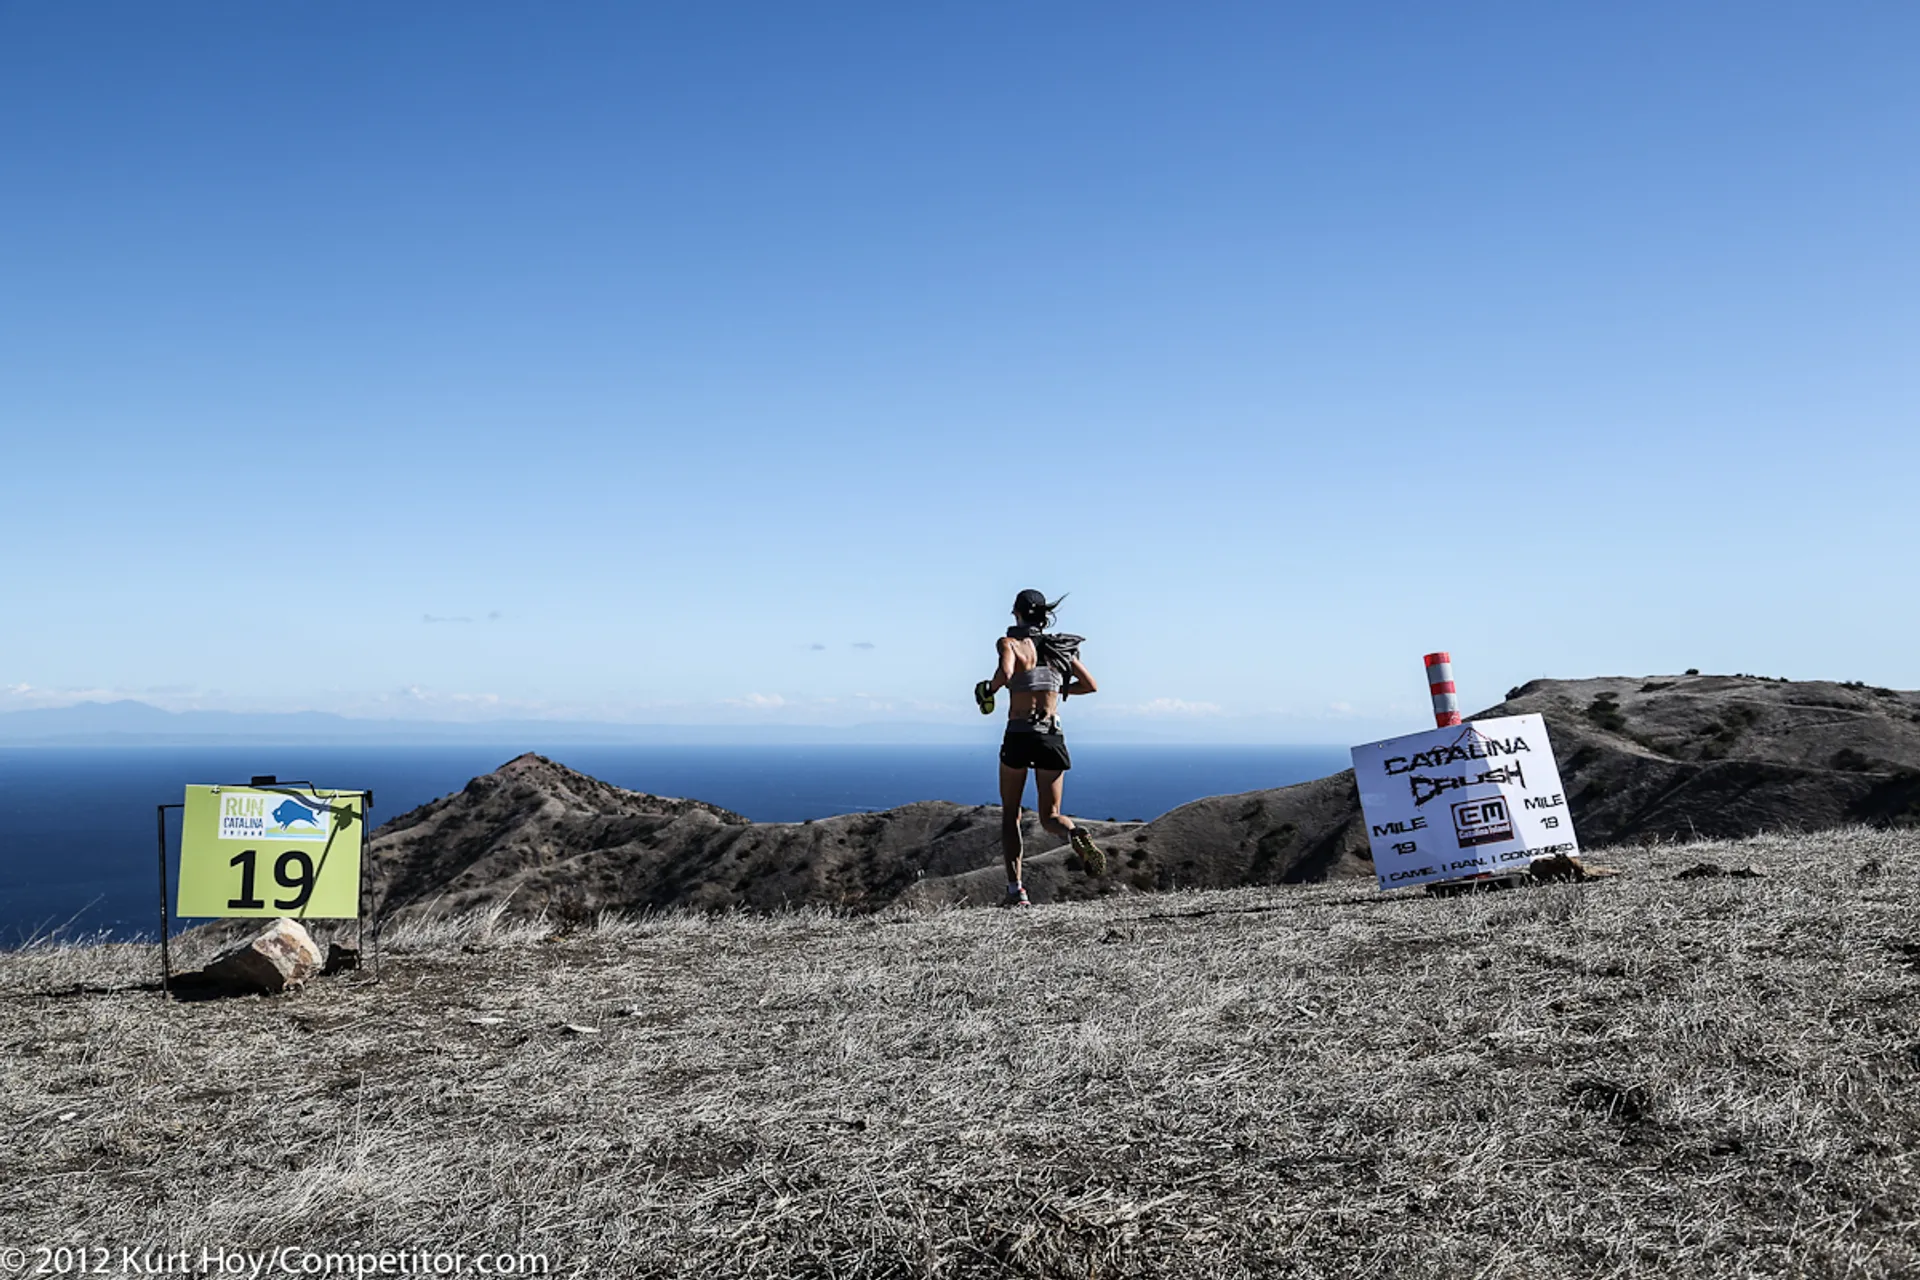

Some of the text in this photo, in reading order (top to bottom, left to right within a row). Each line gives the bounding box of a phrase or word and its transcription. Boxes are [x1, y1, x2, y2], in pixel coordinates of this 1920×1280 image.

[1384, 737, 1531, 776] CATALINA
[1409, 759, 1527, 807] CRUSH
[225, 797, 264, 816] RUN
[1524, 794, 1564, 811] MILE
[223, 817, 264, 829] CATALINA
[1372, 816, 1429, 837] MILE
[1539, 816, 1560, 830] 19
[1391, 841, 1417, 856] 19
[1381, 875, 1386, 884] I
[1442, 864, 1447, 873] I
[1491, 855, 1496, 863] I
[227, 850, 315, 910] 19
